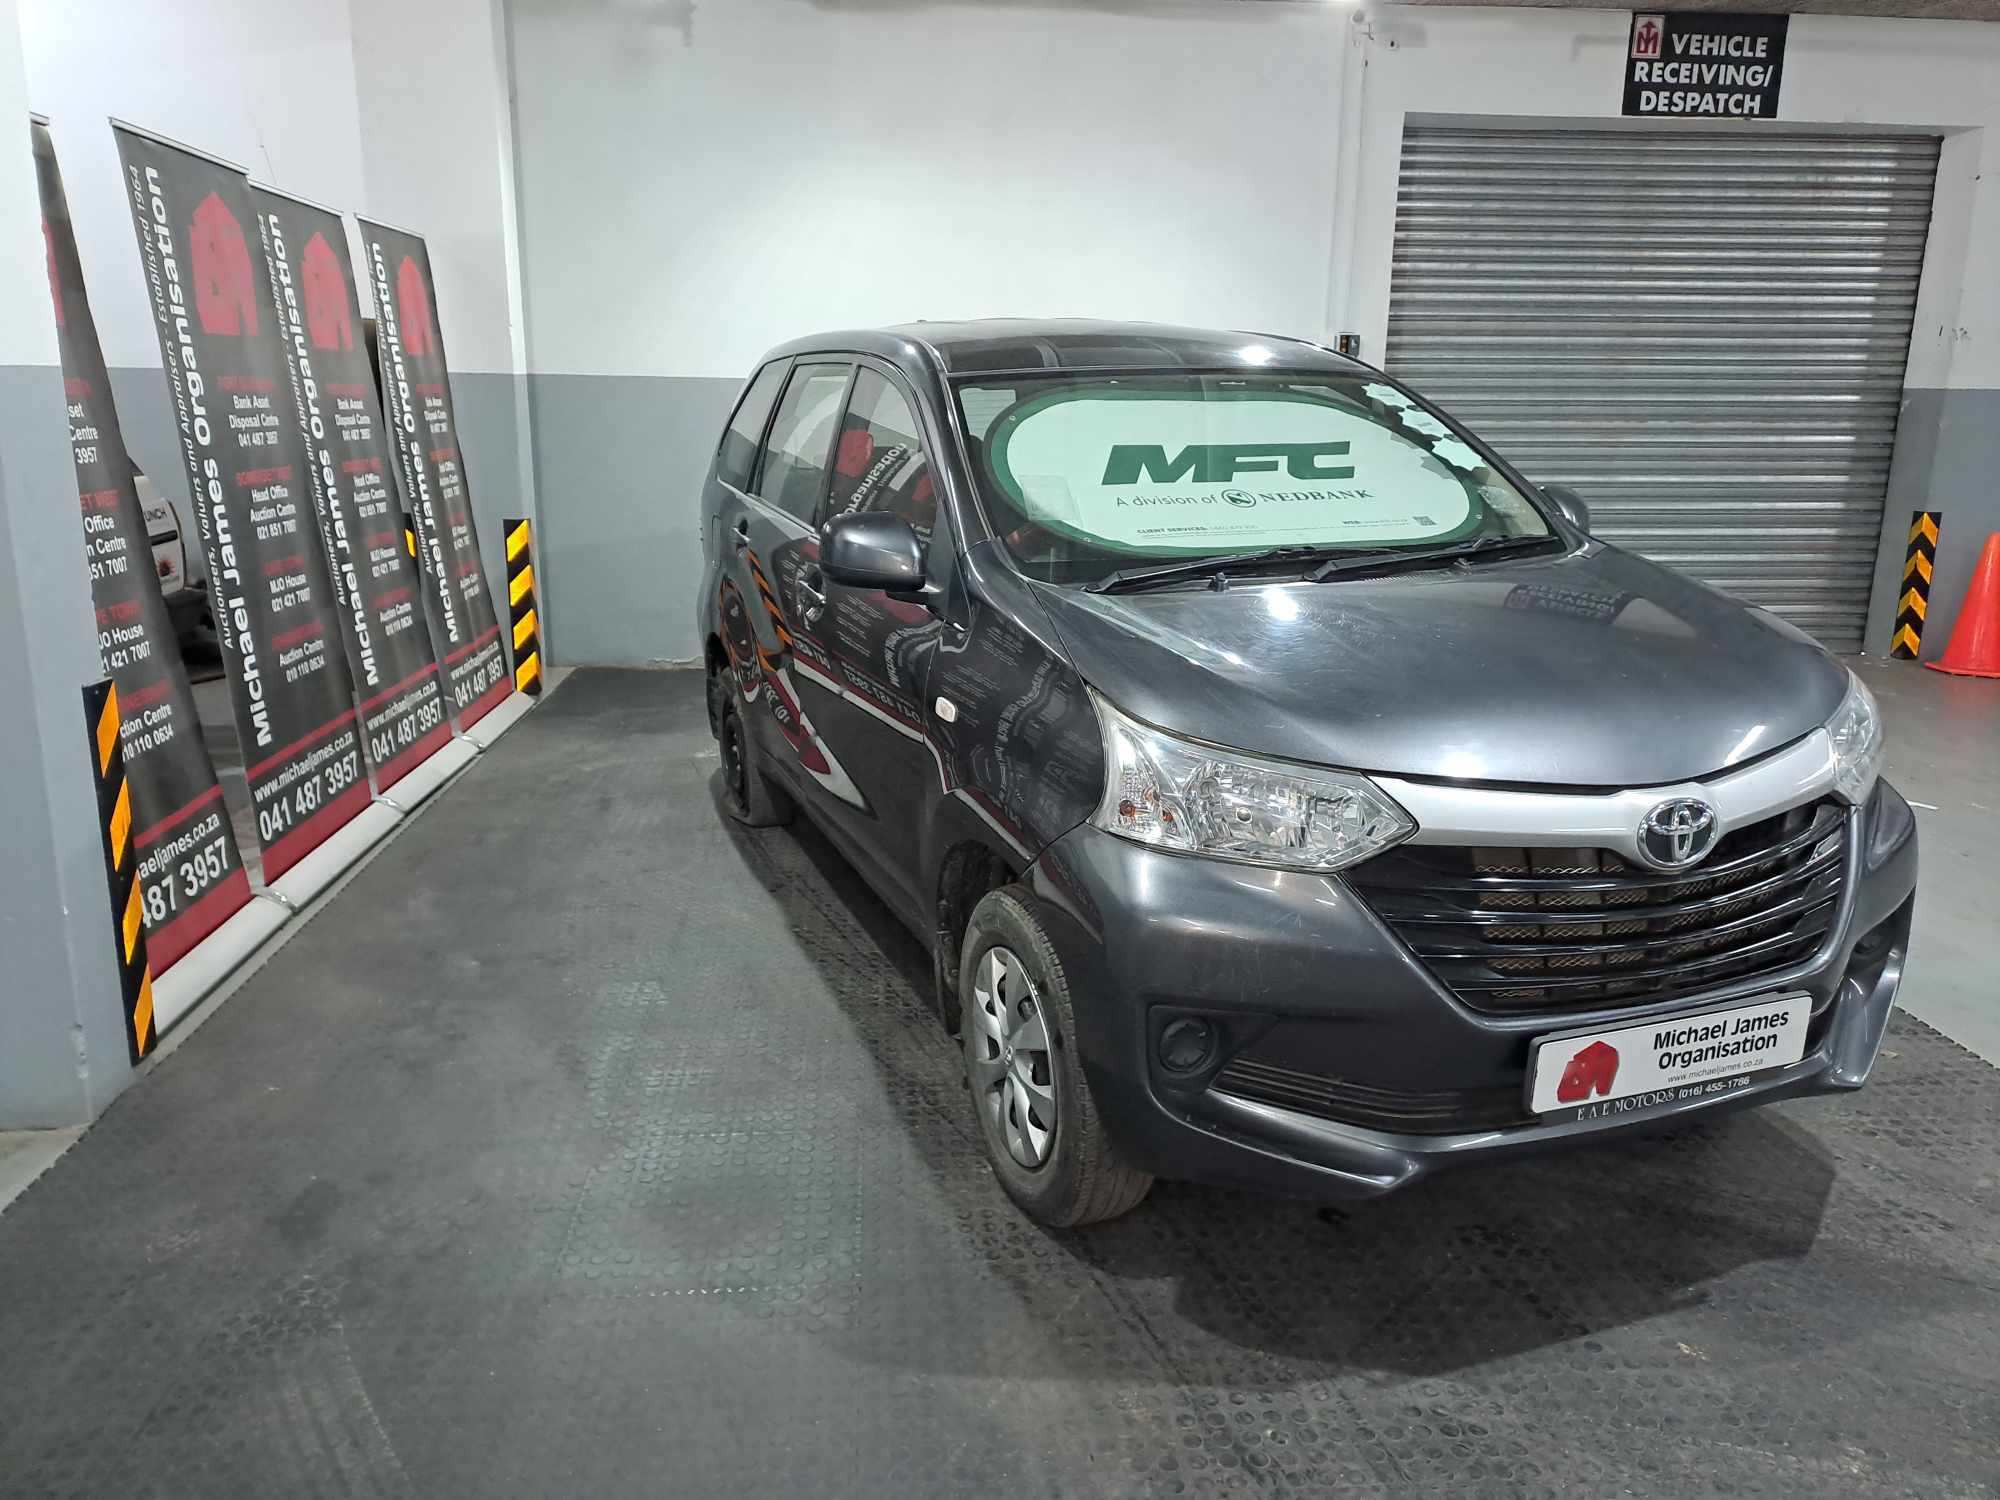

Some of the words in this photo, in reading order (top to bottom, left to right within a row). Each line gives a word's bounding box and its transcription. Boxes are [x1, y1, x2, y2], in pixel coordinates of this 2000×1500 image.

[1671, 33, 1768, 58] VEHICLE
[1633, 61, 1773, 87] RECEIVING/
[1639, 90, 1761, 115] DESPATCH
[129, 165, 146, 211] 1964
[138, 216, 168, 324] Established
[145, 166, 211, 446] Organisation
[268, 213, 325, 440] Organisation
[372, 242, 416, 434] Organisation
[166, 339, 191, 434] Appraisers
[75, 447, 98, 464] 3957
[184, 437, 198, 472] and
[302, 432, 315, 461] and
[1101, 441, 1355, 485] MFC
[193, 476, 211, 540] Valuers
[310, 464, 326, 516] Valuers
[319, 449, 350, 554] James
[410, 441, 436, 530] James
[1116, 496, 1129, 507] A
[1131, 493, 1199, 507] division
[1201, 493, 1218, 505] of
[1258, 489, 1375, 503] NEDBANK
[84, 514, 115, 533] Office
[95, 535, 127, 555] Centre
[204, 458, 240, 586] James
[105, 556, 128, 575] 7007
[208, 547, 234, 649] Auctioneers,
[428, 538, 459, 643] Michael
[112, 623, 144, 645] House
[341, 563, 379, 686] Michael
[110, 650, 129, 669] 421
[130, 641, 151, 662] 7007
[228, 597, 273, 747] Michael
[455, 680, 474, 708] 041
[473, 668, 487, 694] 487
[487, 655, 504, 684] 3957
[144, 703, 172, 726] Centre
[153, 723, 174, 746] 0634
[371, 728, 396, 763] 041
[397, 714, 417, 745] 487
[417, 697, 442, 732] 3957
[254, 731, 353, 803] www.michaeljames.co.za
[260, 796, 292, 841] 041
[296, 775, 321, 815] 487
[325, 750, 358, 795] 3957
[180, 836, 228, 896] 3957
[1653, 1020, 1727, 1050] Michael
[1731, 1011, 1789, 1036] James
[1658, 1033, 1778, 1070] Organisation
[1614, 1088, 1675, 1113] MOTORS
[1679, 1085, 1703, 1100] (016)
